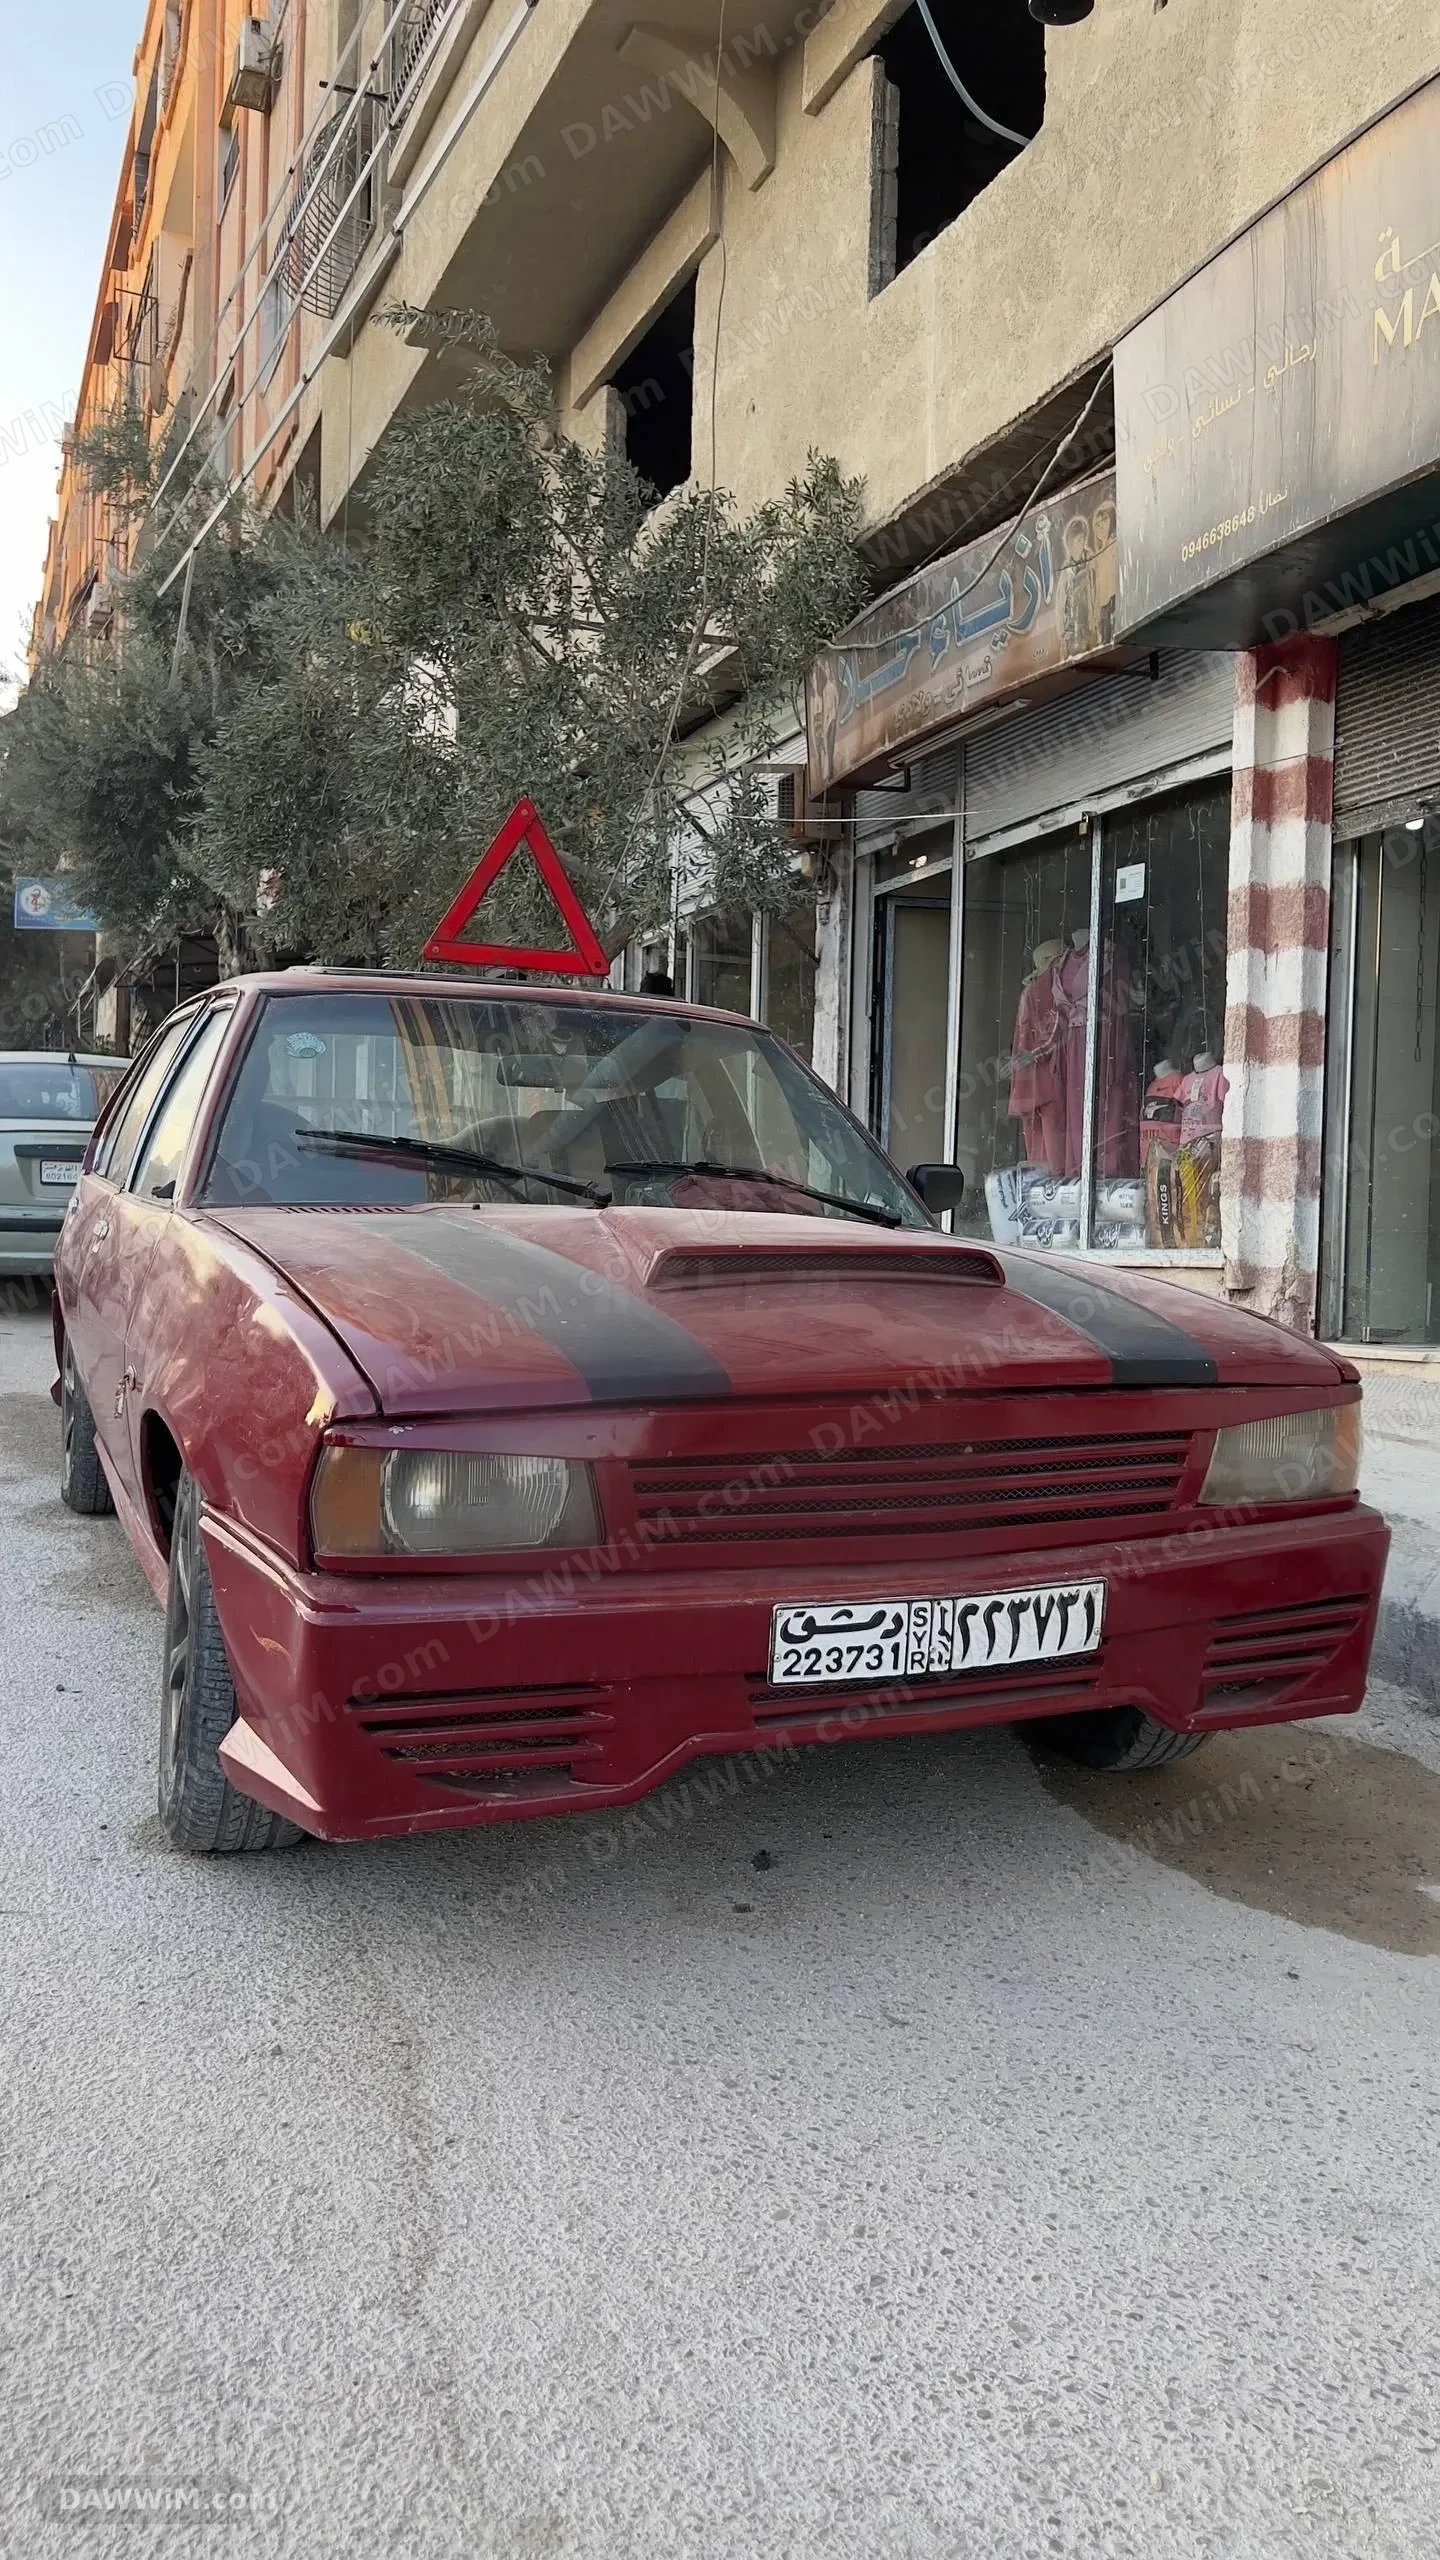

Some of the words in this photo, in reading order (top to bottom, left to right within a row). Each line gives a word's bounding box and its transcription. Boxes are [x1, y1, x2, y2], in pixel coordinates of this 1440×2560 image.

[1181, 505, 1255, 562] 0946638648
[1160, 1184, 1169, 1225] KINGS
[780, 1609, 904, 1645] دمشق
[911, 1606, 928, 1671] SYR
[957, 1589, 1096, 1662] ٢٢٣٧٣١
[782, 1641, 900, 1676] 223731
